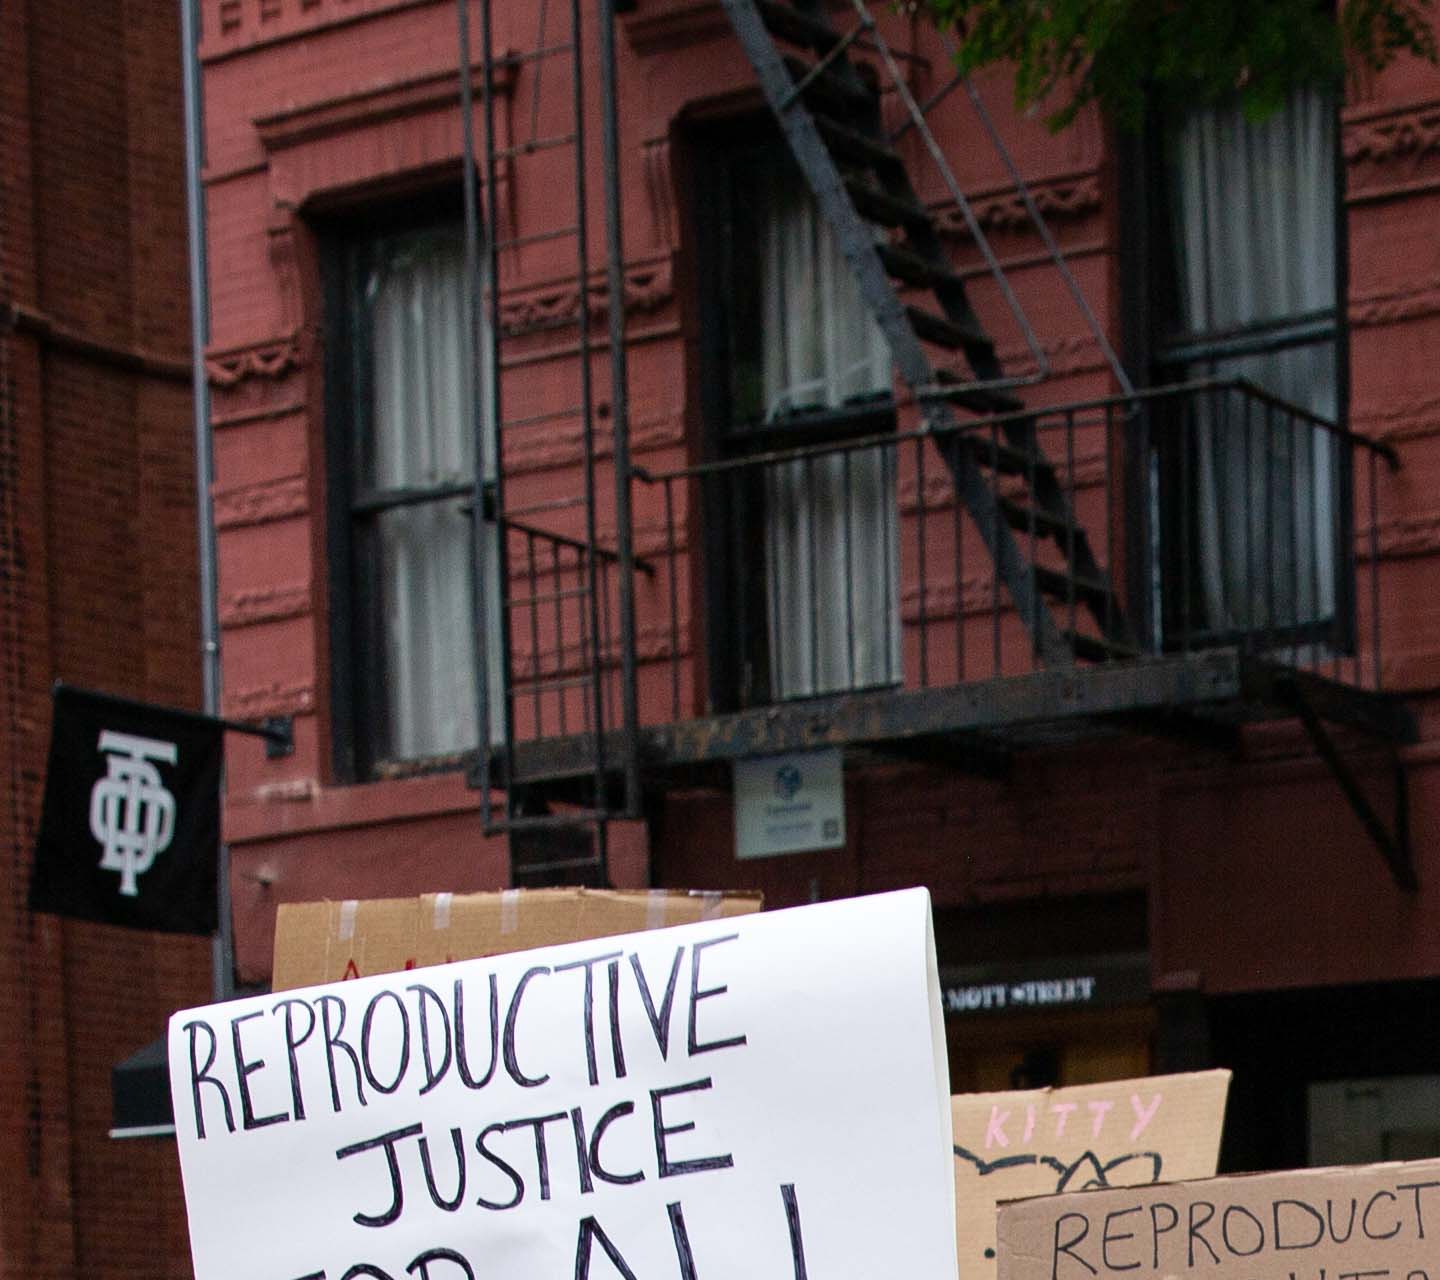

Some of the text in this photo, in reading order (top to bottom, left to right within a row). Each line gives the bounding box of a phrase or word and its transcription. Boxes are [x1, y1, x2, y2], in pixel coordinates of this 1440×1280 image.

[182, 932, 746, 1140] REPRODUCTIVE
[335, 1076, 733, 1227] JUSTICE
[982, 1093, 1163, 1150] KITTY
